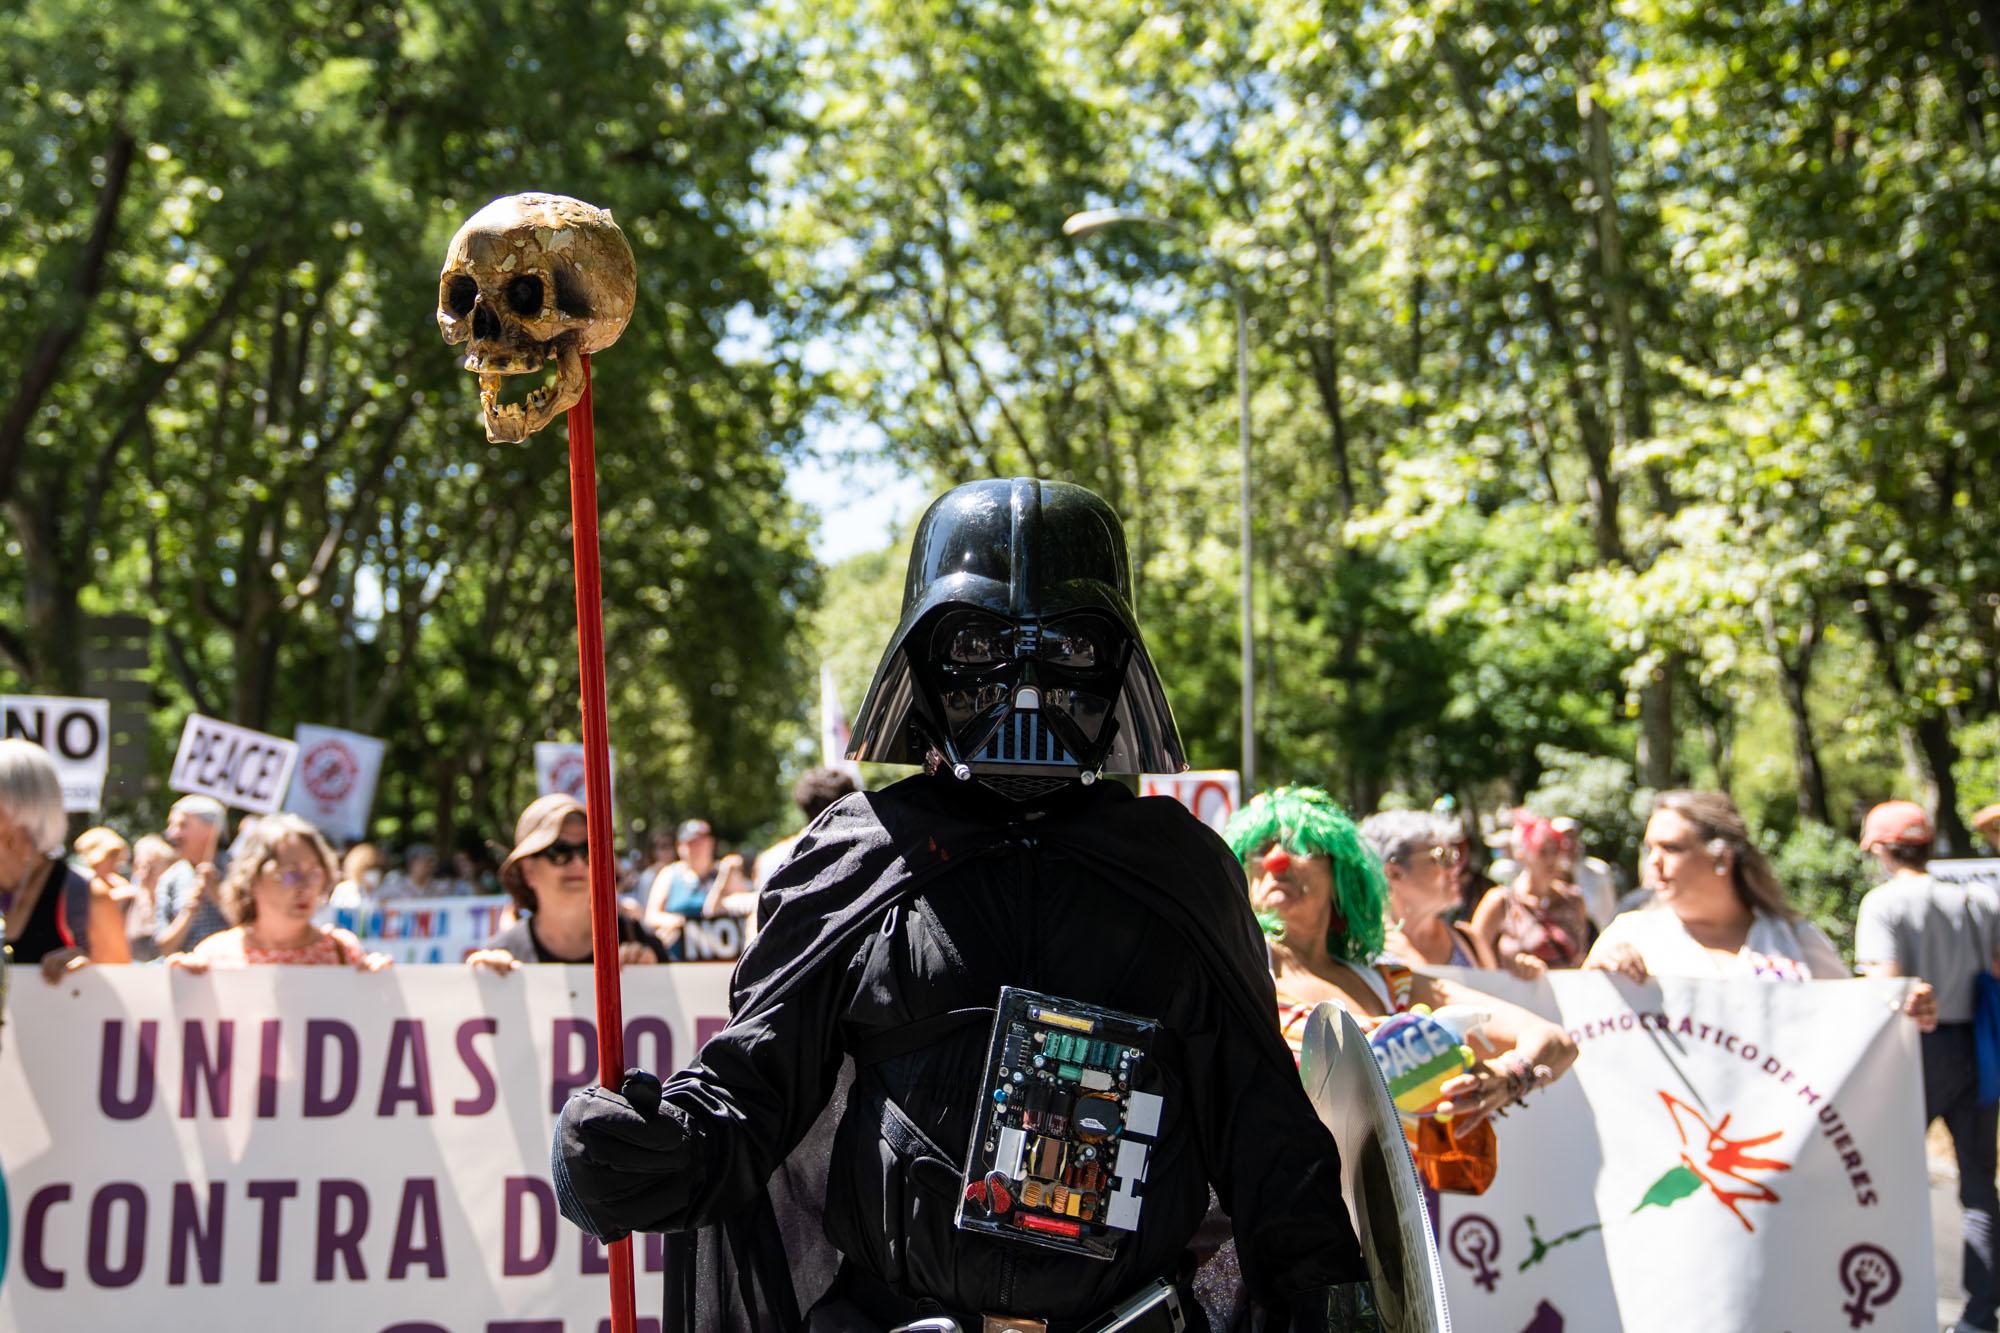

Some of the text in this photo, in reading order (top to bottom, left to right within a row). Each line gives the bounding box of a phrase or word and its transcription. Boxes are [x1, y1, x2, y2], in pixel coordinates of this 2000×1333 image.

[6, 707, 99, 761] NO
[181, 729, 279, 801] PEACE
[97, 1017, 498, 1121] UNIDAS
[1371, 1018, 1450, 1083] PACE
[1798, 1085, 1878, 1207] MUJERES
[21, 1177, 447, 1290] CONTRA
